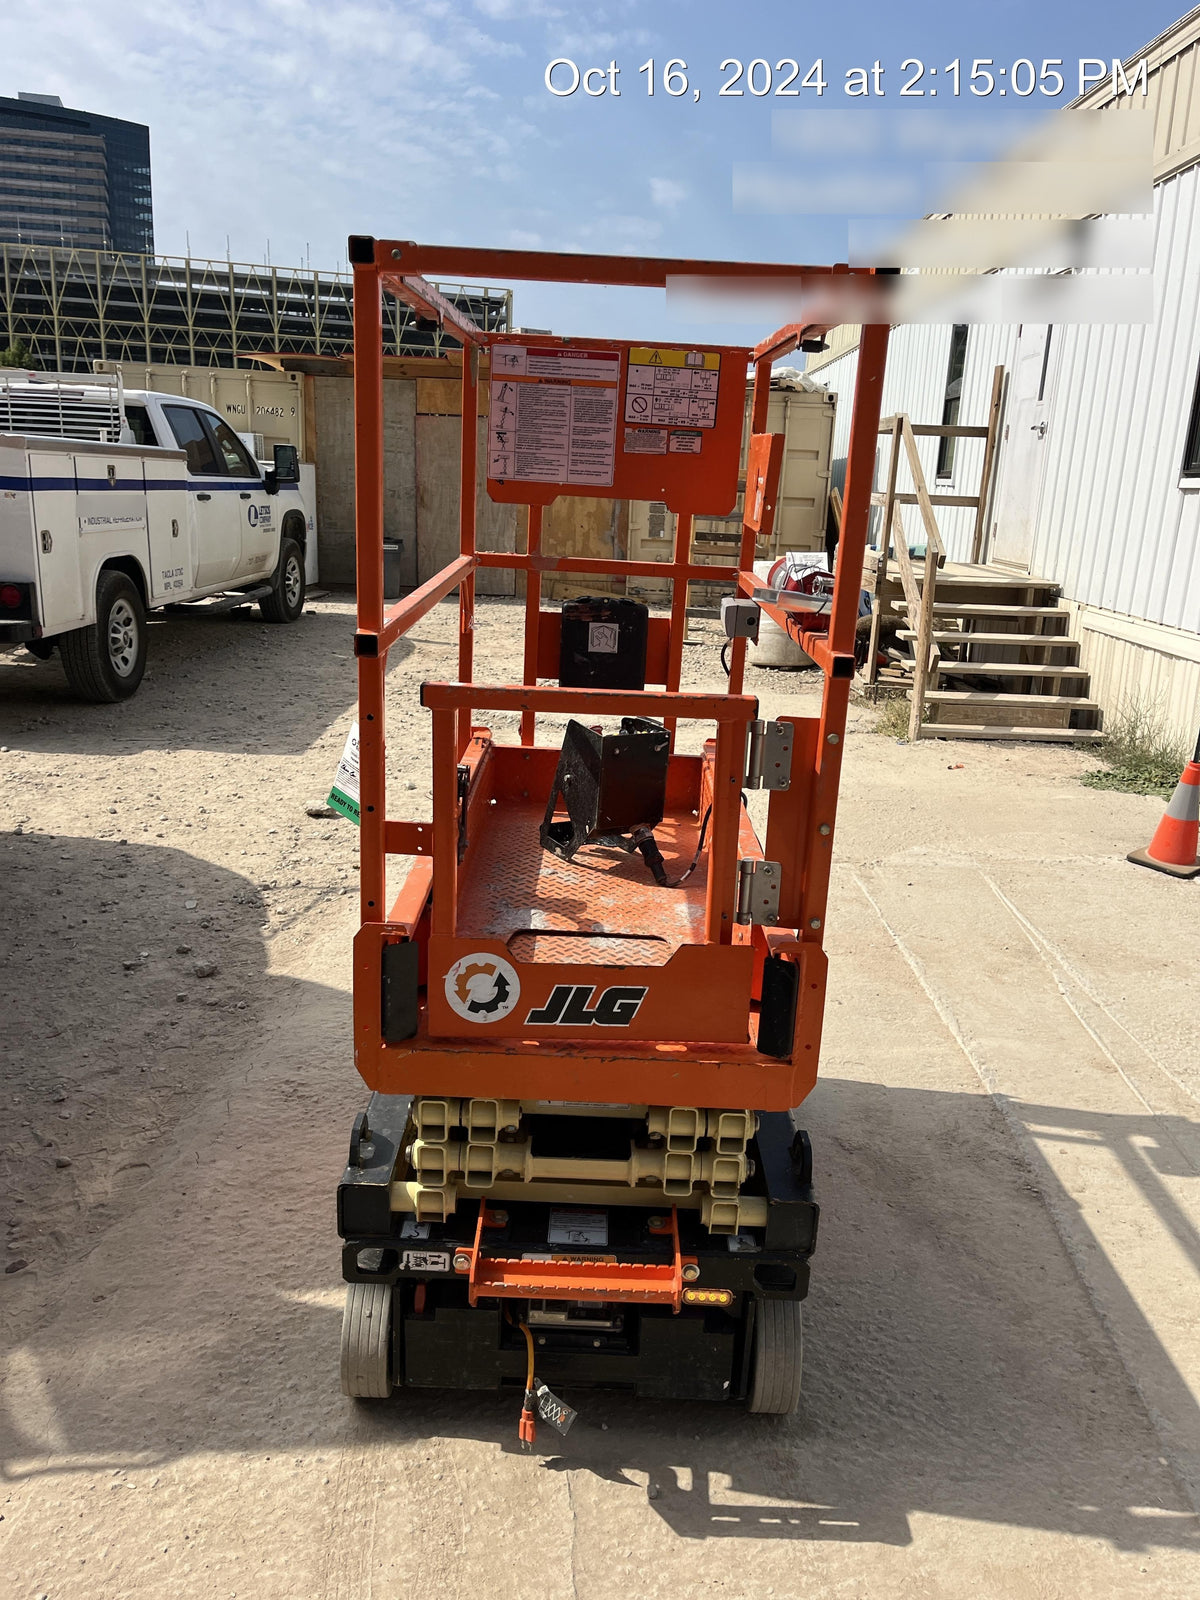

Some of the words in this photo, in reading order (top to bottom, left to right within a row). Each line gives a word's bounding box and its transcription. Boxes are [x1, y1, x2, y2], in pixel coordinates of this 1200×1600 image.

[543, 378, 571, 386] WARNING
[226, 404, 246, 415] WNGU
[330, 792, 347, 809] READY
[346, 803, 354, 813] TO
[524, 985, 649, 1027] JLG
[570, 1256, 604, 1264] WARNING
